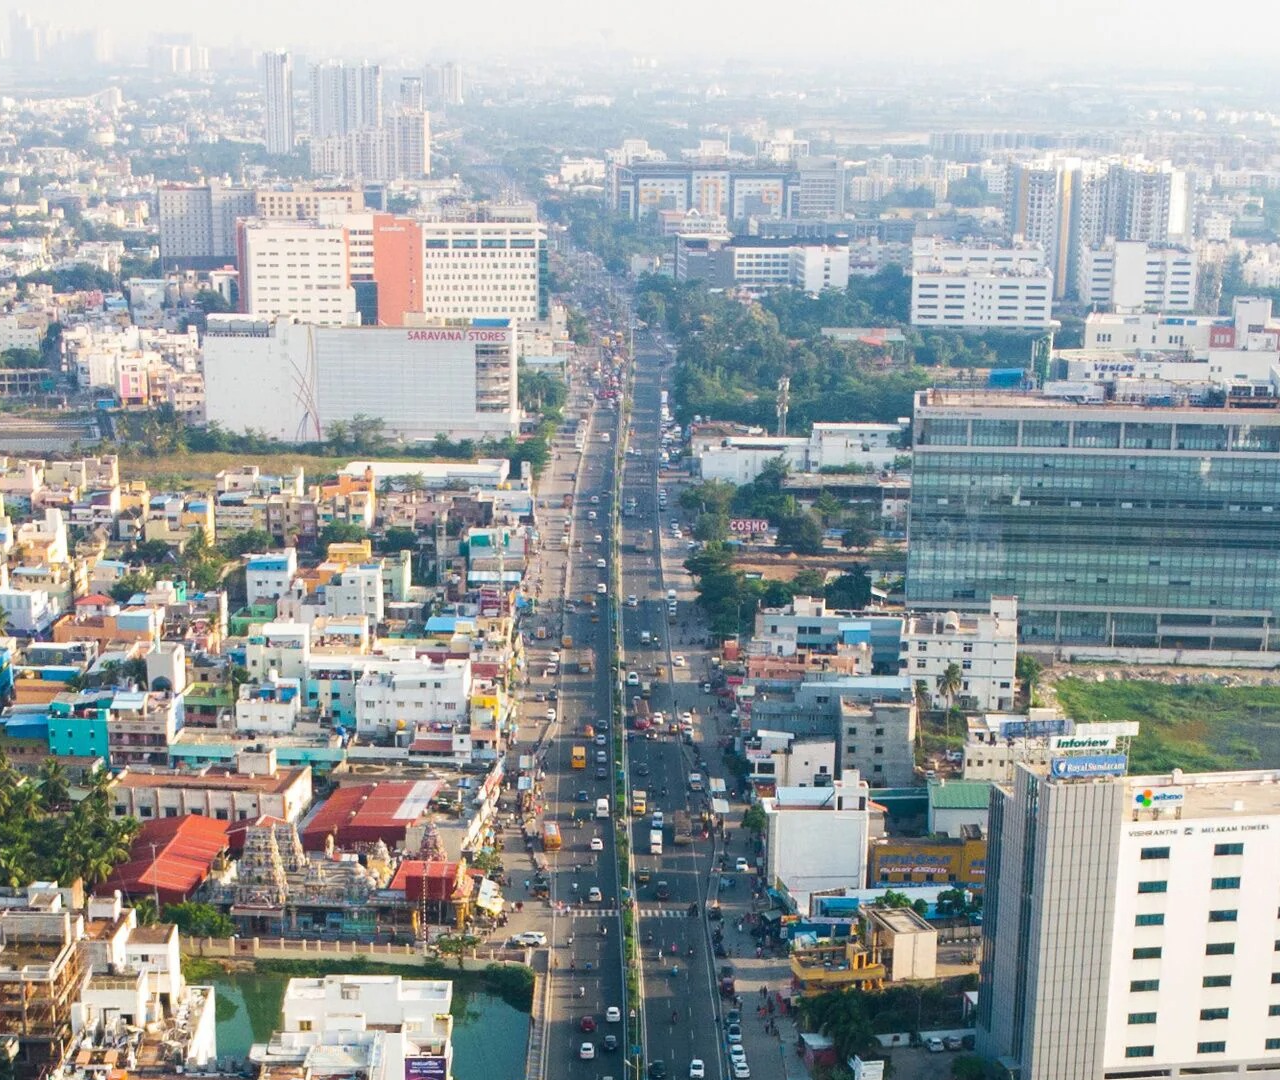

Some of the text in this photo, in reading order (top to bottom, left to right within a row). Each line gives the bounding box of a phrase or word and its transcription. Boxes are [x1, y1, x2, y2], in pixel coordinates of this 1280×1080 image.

[408, 330, 506, 341] SARAVANA STORES
[1094, 363, 1134, 372] Vestas
[730, 521, 768, 531] COSMO
[1056, 738, 1109, 748] Infoview
[1067, 763, 1088, 772] Royal
